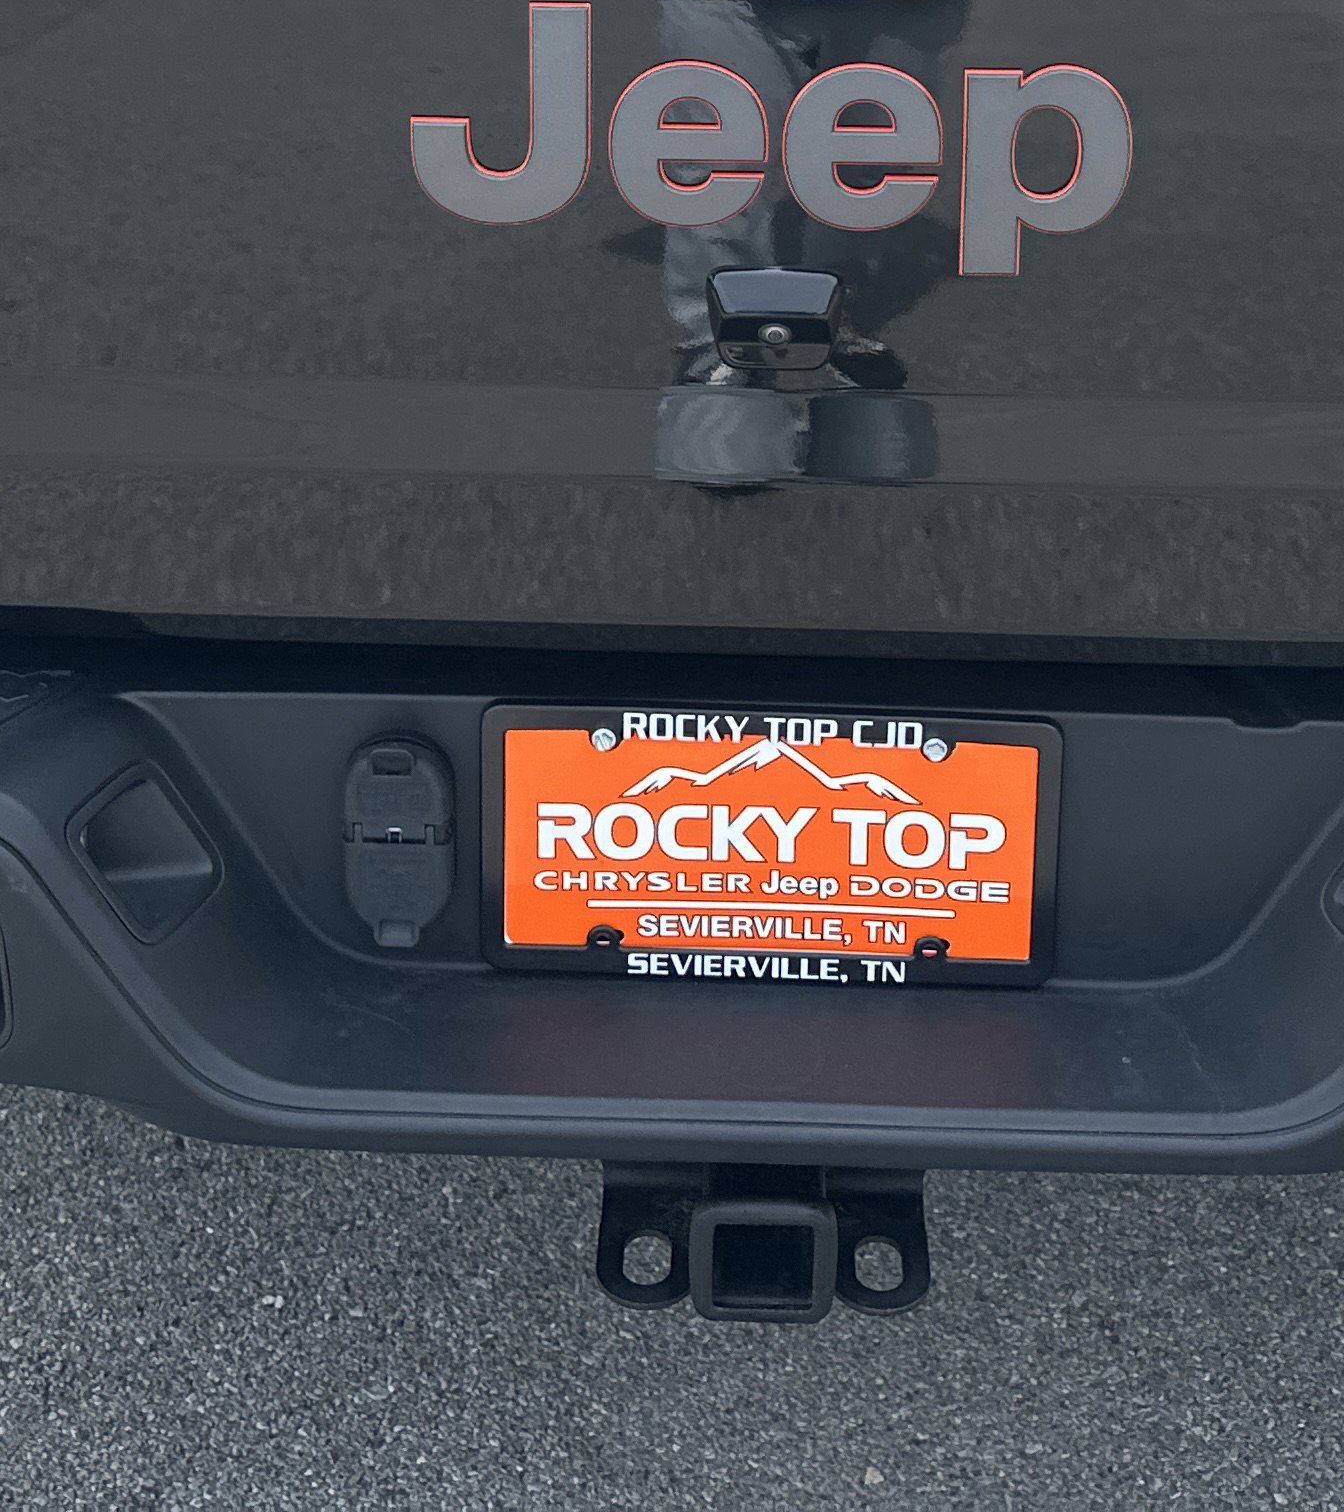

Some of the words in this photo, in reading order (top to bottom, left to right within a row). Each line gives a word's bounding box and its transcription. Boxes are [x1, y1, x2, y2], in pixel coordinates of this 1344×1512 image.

[409, 1, 1134, 277] Jeep
[622, 712, 751, 743] ROCKY
[763, 717, 839, 746] TOP
[852, 720, 924, 750] CJD
[536, 802, 819, 865] ROCKY
[833, 809, 1008, 871] TOP
[534, 870, 750, 895] CHRYSLER
[761, 869, 840, 899] Jeep
[849, 876, 1011, 903] DODGE
[637, 915, 853, 947] SEVIERVILLE,
[863, 919, 907, 945] TN
[627, 952, 848, 983] SEVIERVILLE,
[861, 959, 907, 984] TN
